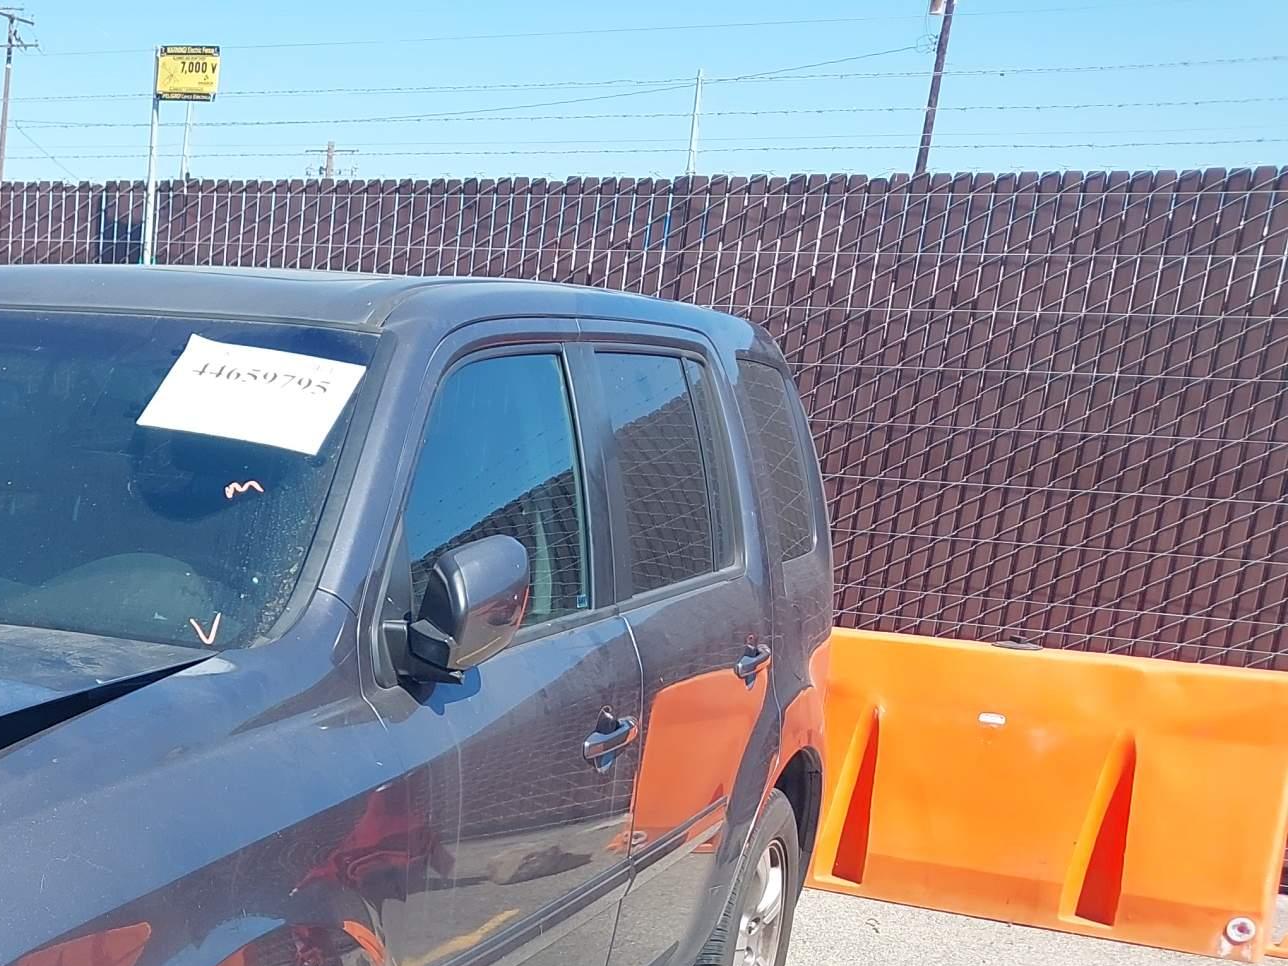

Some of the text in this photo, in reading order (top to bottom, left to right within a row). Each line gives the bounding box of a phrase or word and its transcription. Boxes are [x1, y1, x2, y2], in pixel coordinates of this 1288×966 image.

[180, 61, 218, 75] 7,000 V
[192, 362, 331, 395] 44659795
